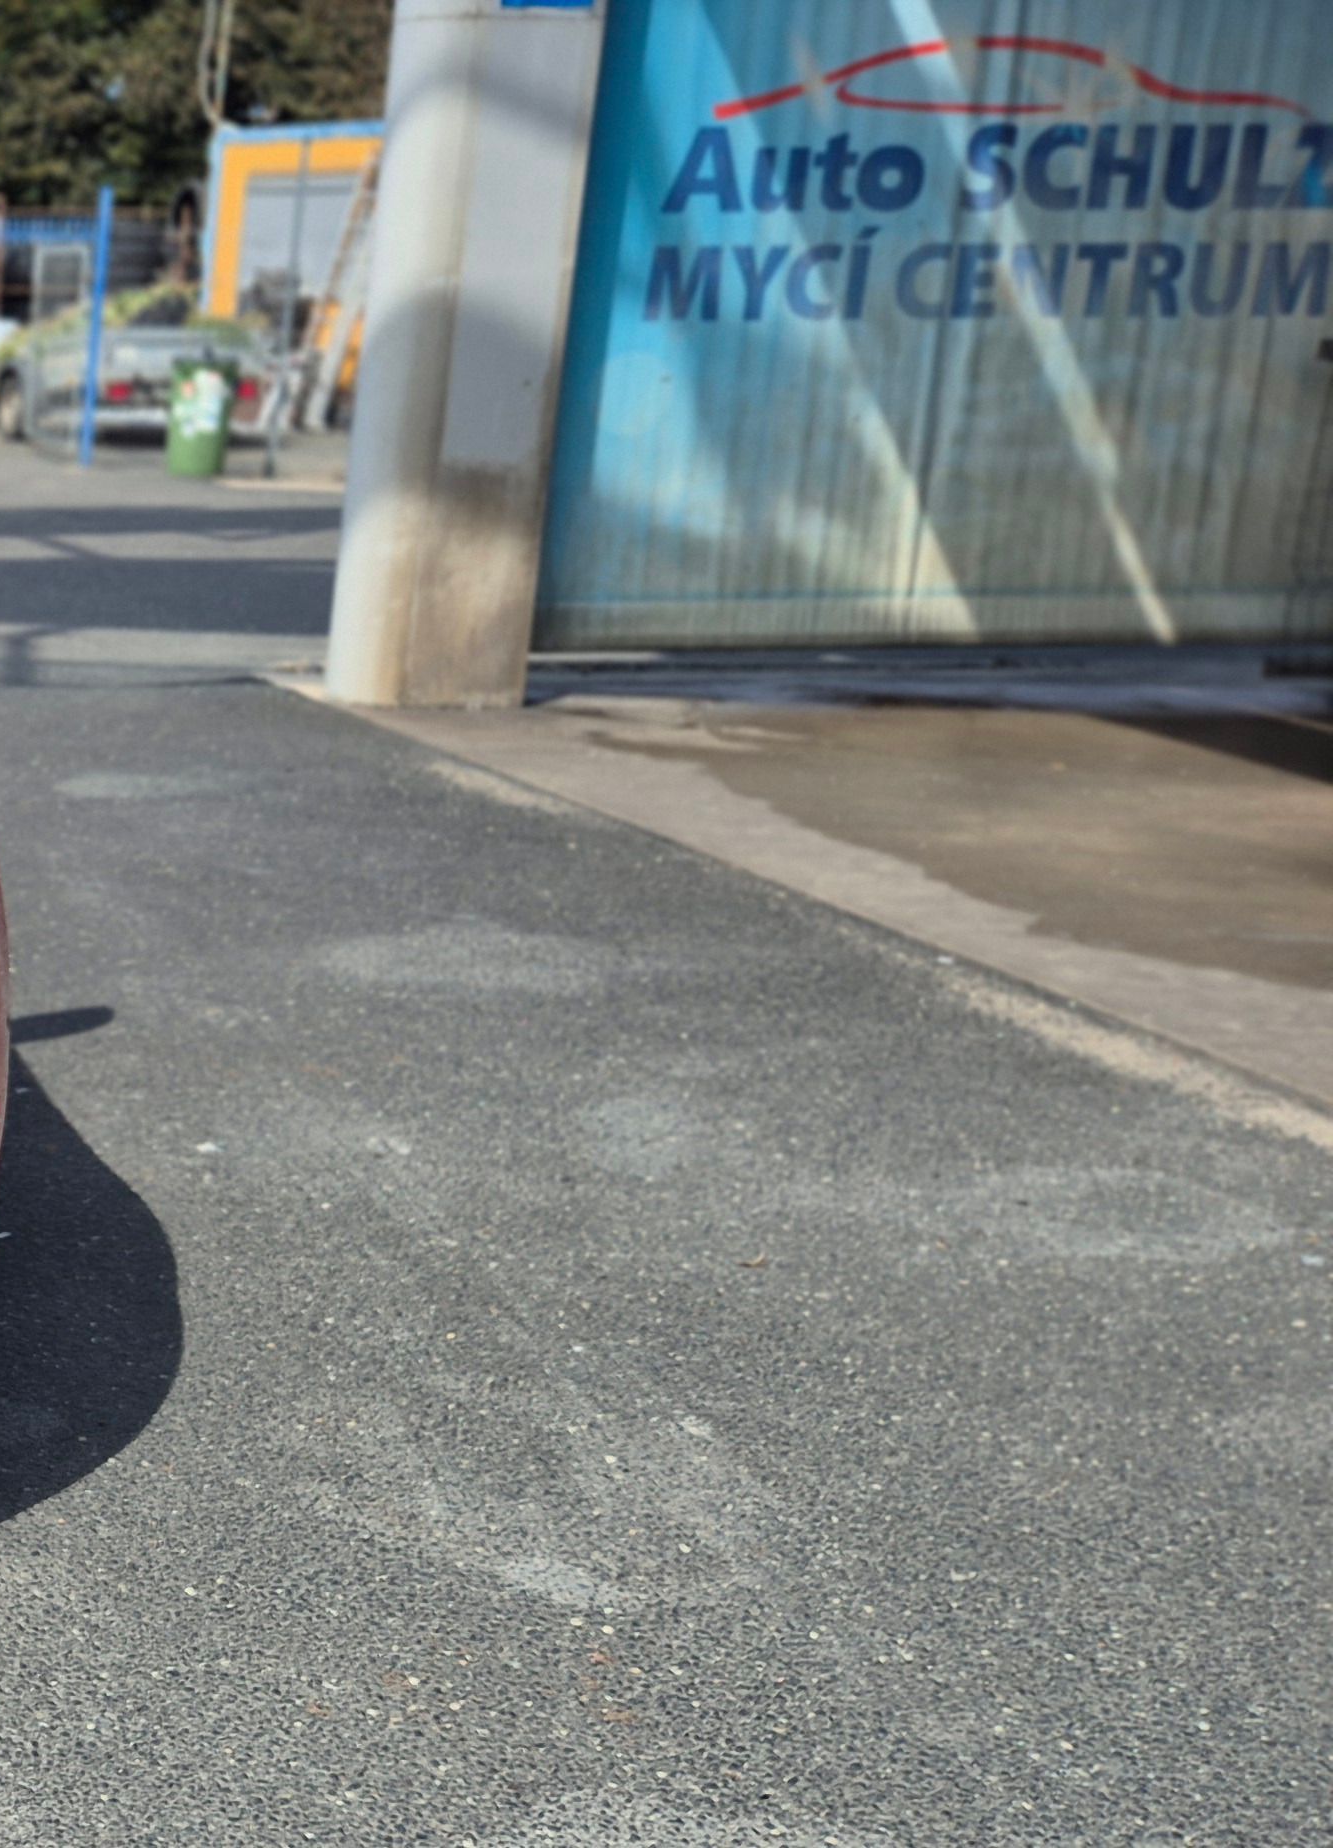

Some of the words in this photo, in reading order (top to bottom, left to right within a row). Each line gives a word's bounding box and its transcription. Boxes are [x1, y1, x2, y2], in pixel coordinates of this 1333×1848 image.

[661, 125, 925, 213] Auto
[962, 122, 1333, 212] SCHULZ
[643, 225, 881, 322] MYCÍ
[895, 241, 1332, 319] CENTRUM
